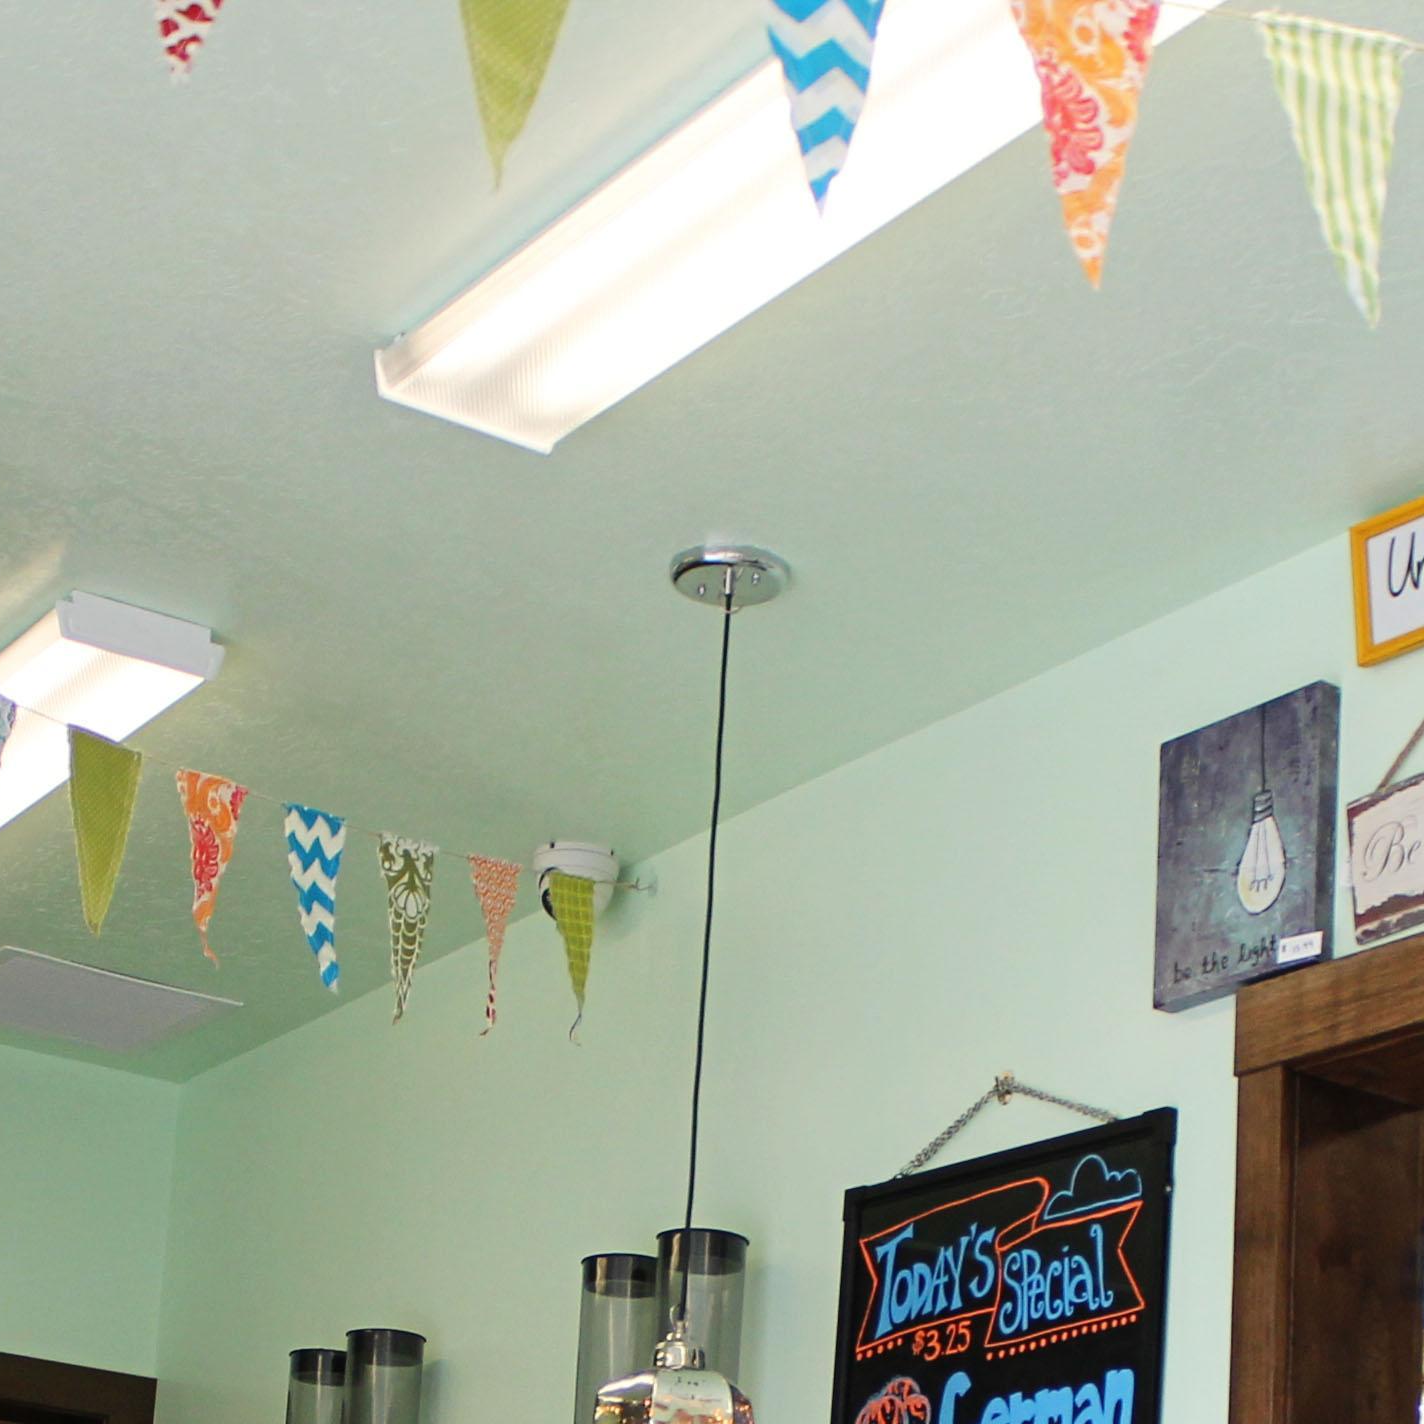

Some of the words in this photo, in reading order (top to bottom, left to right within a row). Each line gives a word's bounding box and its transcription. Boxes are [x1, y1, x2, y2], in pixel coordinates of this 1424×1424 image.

[1362, 820, 1422, 881] Be
[1173, 962, 1193, 984] be
[1203, 951, 1229, 975] the
[1238, 934, 1277, 967] light
[912, 1320, 972, 1361] $3.25
